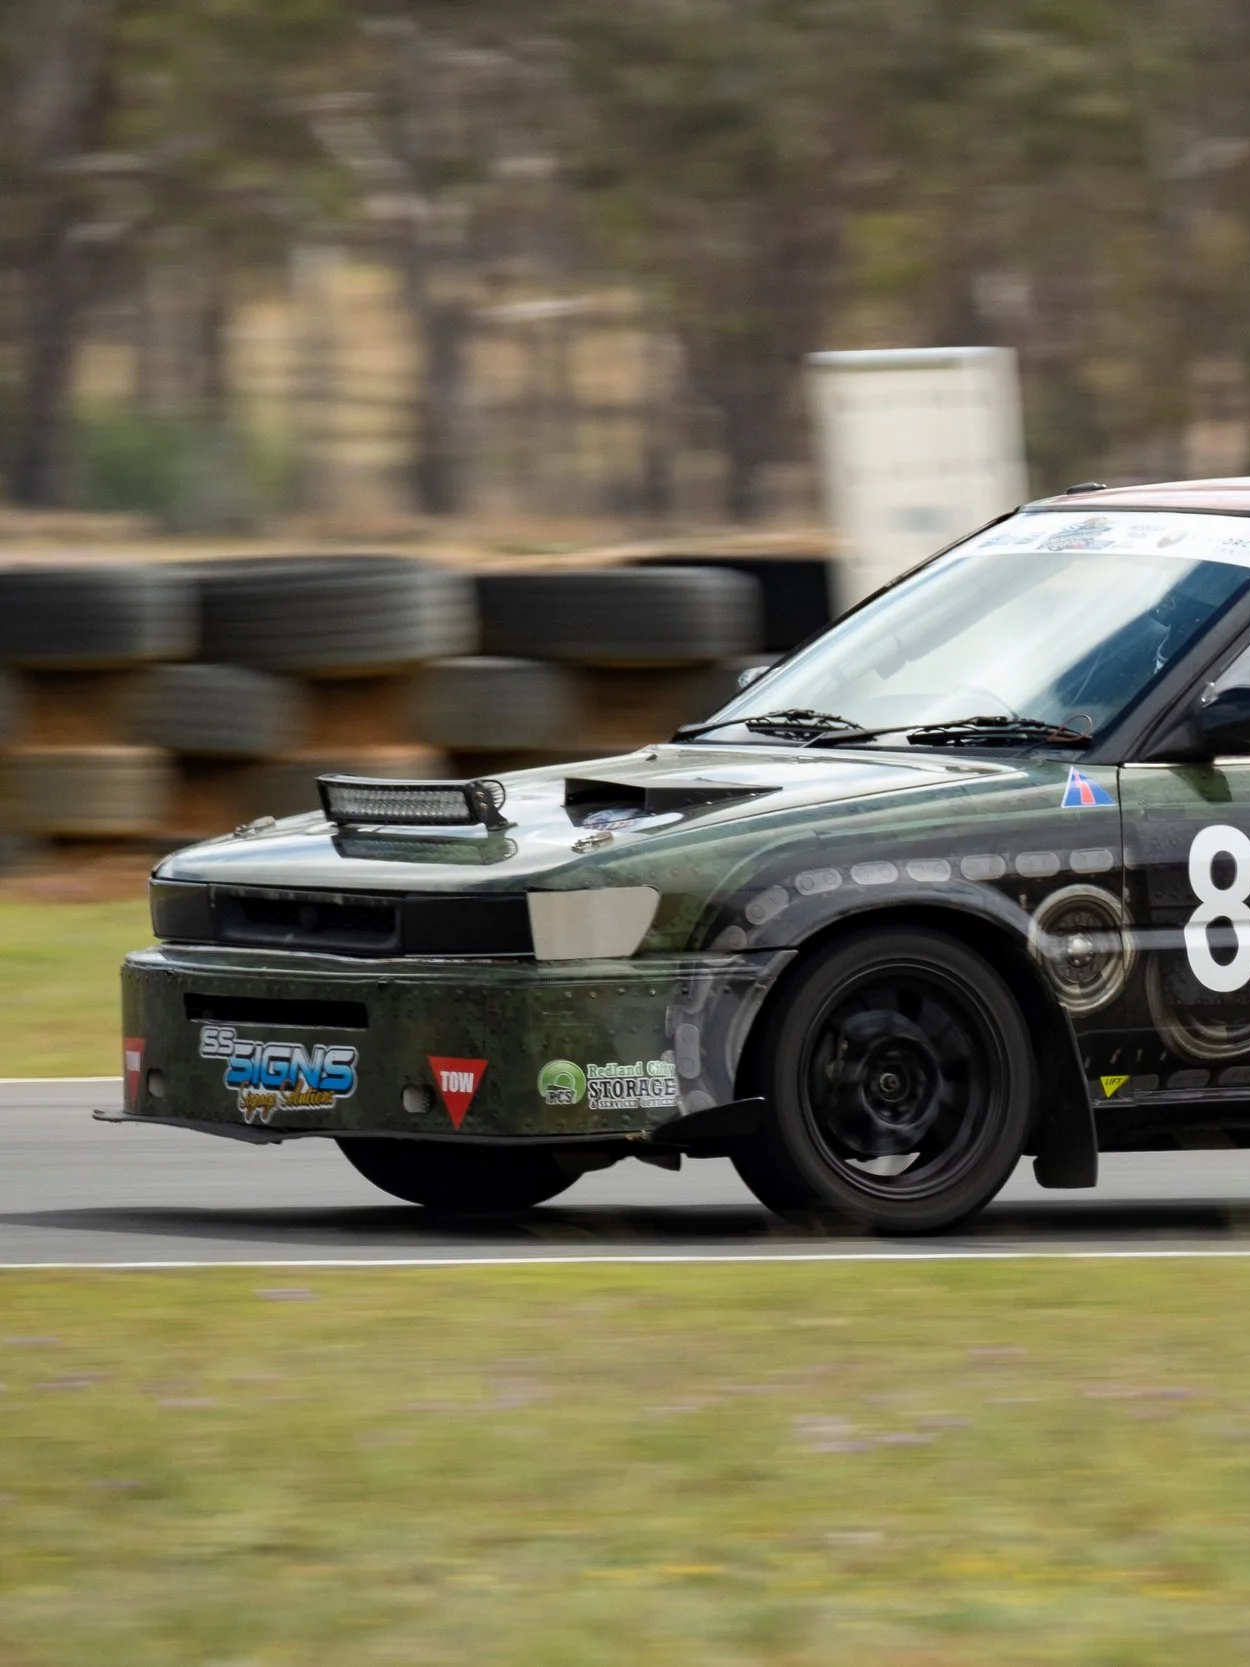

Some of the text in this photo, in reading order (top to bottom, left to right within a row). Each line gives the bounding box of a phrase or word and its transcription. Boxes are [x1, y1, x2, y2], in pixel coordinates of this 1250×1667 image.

[203, 1028, 356, 1092] SS SIGNS
[588, 1062, 642, 1077] Redland
[440, 1071, 474, 1092] TOW
[588, 1078, 676, 1099] STORAGE
